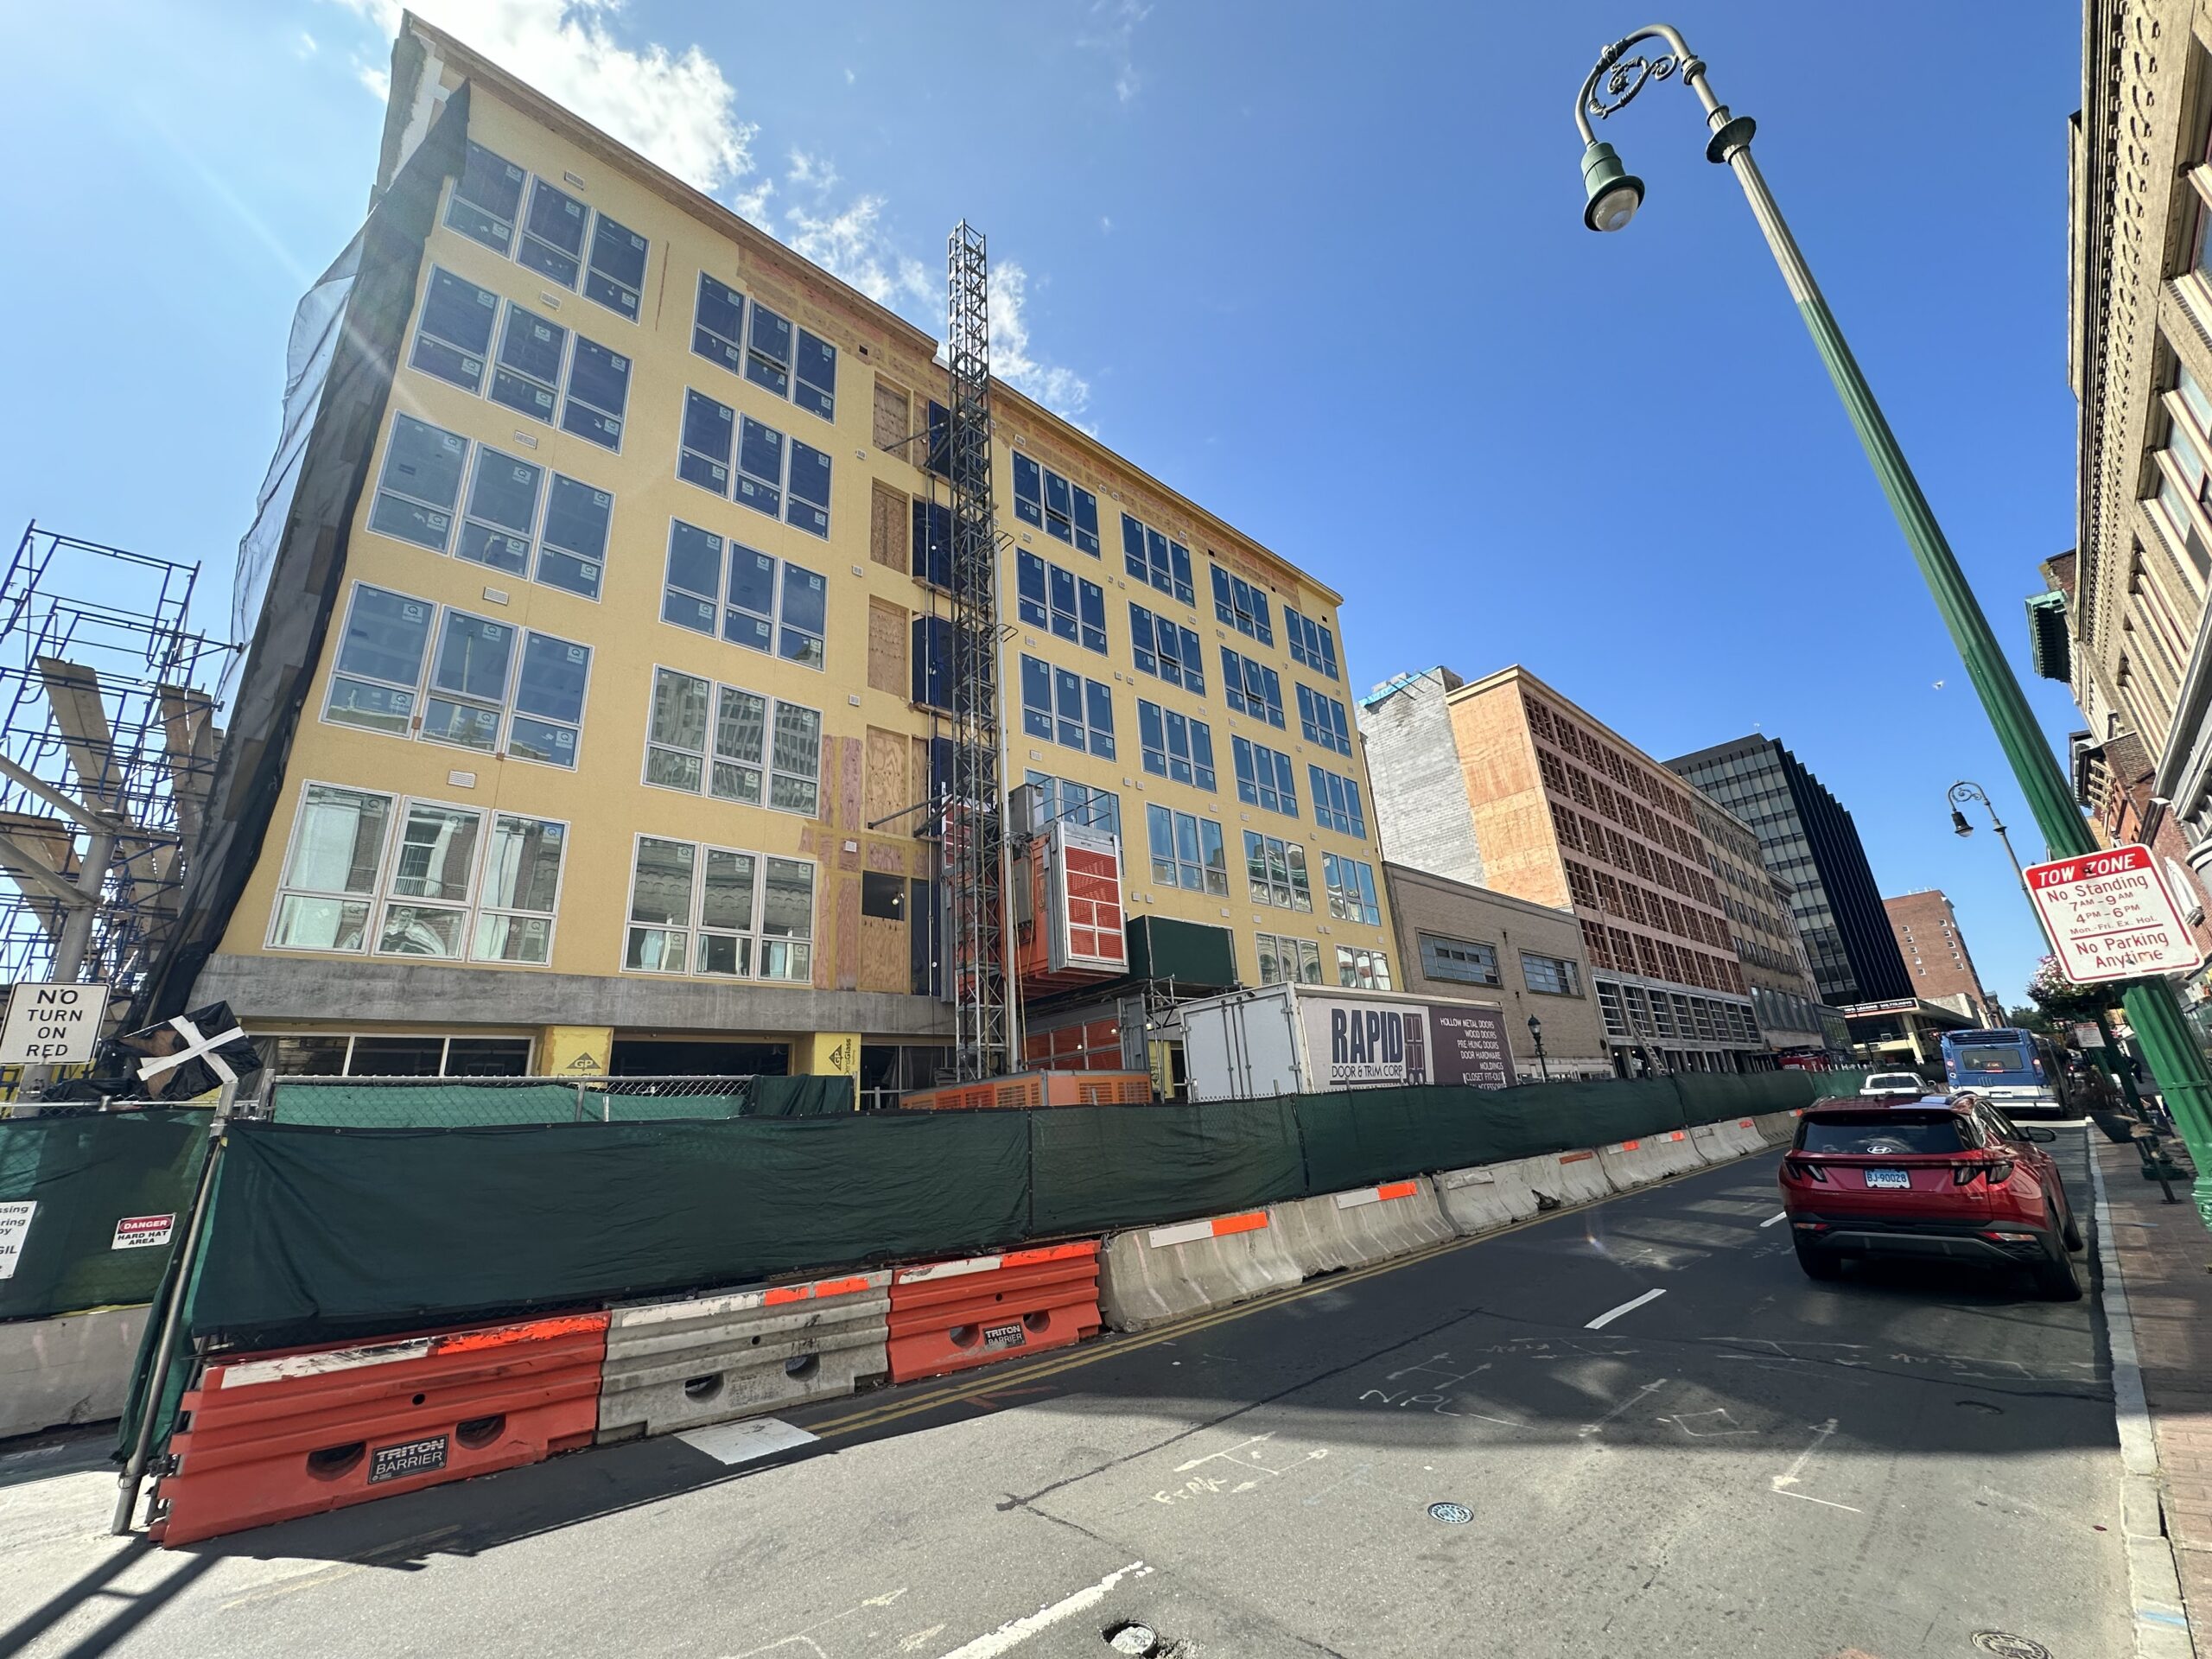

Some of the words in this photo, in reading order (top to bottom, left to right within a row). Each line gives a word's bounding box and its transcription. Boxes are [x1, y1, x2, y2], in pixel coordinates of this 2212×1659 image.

[2038, 865, 2075, 886] TOW
[2085, 853, 2135, 878] ZONE
[2047, 890, 2069, 903] No
[2075, 875, 2149, 897] Standing
[2075, 942, 2099, 955] No
[2104, 932, 2170, 951] Parking
[2095, 950, 2164, 968] Anytime
[37, 988, 79, 1005] NO
[28, 1009, 83, 1022] TURN
[1440, 1017, 1462, 1027] HOLLOW
[1462, 1019, 1478, 1028] METAL
[1478, 1020, 1495, 1029] DOORS
[37, 1027, 67, 1039] ON
[1332, 1008, 1403, 1063] RAPID
[1465, 1030, 1480, 1039] WOOD
[1481, 1030, 1497, 1039] DOORS
[26, 1044, 68, 1057] RED
[1457, 1039, 1483, 1049] PRE-HUNG
[1483, 1040, 1499, 1050] DOORS
[834, 1051, 841, 1065] GP
[1460, 1051, 1476, 1059] DOOR
[1476, 1052, 1502, 1060] HARDWARE
[575, 1059, 594, 1068] GP
[1332, 1065, 1356, 1077] DOOR
[1357, 1065, 1363, 1077] &
[1363, 1065, 1382, 1077] TRIM
[1383, 1065, 1403, 1077] CORP
[1465, 1072, 1484, 1081] CLOSET
[124, 1219, 168, 1230] DANGER
[985, 1325, 1021, 1338] TRITON
[988, 1332, 1023, 1346] BARRIER
[377, 1439, 445, 1462] TRITON
[376, 1451, 442, 1475] BARRIER
